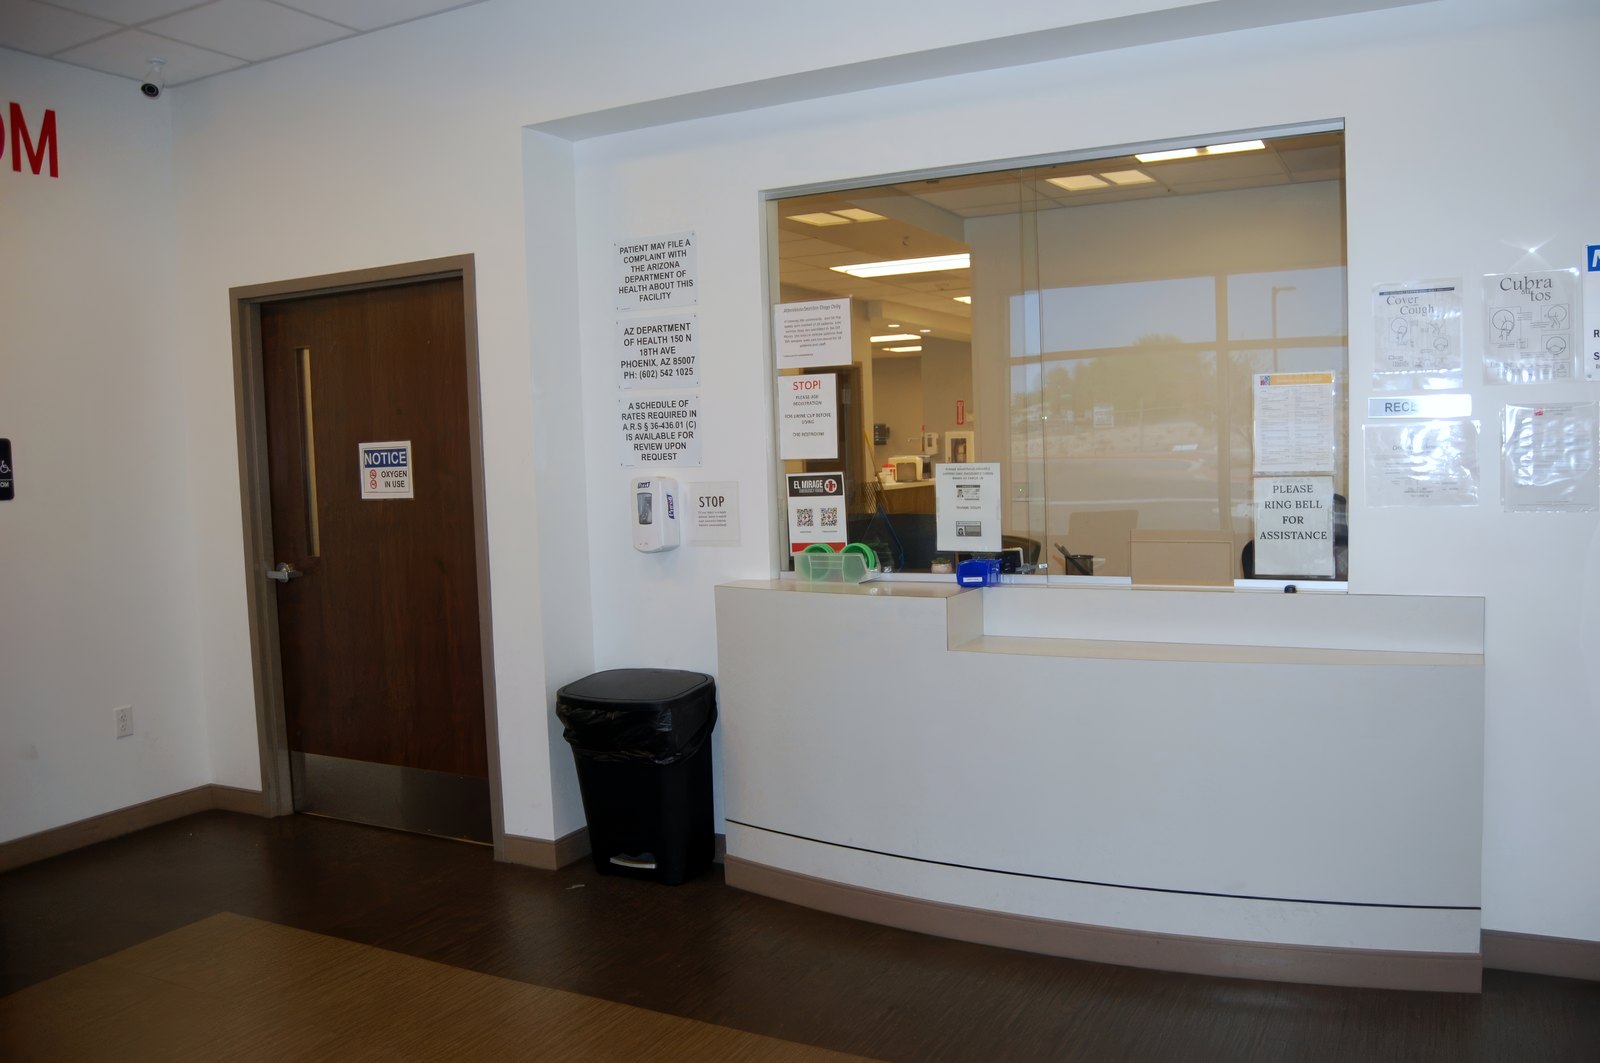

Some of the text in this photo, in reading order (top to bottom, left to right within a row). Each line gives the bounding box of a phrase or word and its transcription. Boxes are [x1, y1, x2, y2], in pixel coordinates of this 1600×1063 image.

[0, 102, 59, 178] M
[619, 244, 648, 254] PATIENT
[650, 242, 665, 251] MAY
[667, 240, 683, 248] FILE
[623, 249, 687, 264] COMPLAINT WITH
[631, 260, 680, 273] THE ARIZONA
[624, 269, 687, 284] DEPARTMENT OF
[618, 279, 694, 294] HEALTH ABOUT THIS
[1500, 276, 1553, 292] Cubra
[639, 291, 671, 302] FACILITY
[1386, 296, 1420, 305] Cover
[1399, 304, 1434, 316] Cough
[624, 322, 691, 336] AZ DEPARTMENT
[623, 333, 692, 347] OF HEALTH 150 N
[639, 346, 676, 356] 18TH AVE
[660, 357, 671, 366] AZ
[672, 356, 695, 366] 85007
[623, 367, 694, 380] PH: (602) 542 1025
[793, 380, 821, 390] STOP!
[628, 399, 689, 411] A SCHEDULE OF
[621, 409, 697, 421] RATES REQUIRED IN
[685, 420, 697, 430] (C)
[625, 430, 694, 441] IS AVAILABLE FOR
[633, 441, 687, 451] REVIEW UPON
[364, 451, 406, 465] NOTICE
[641, 452, 677, 461] REQUEST
[380, 470, 408, 478] OXYGEN
[793, 480, 823, 489] EL MIRAGE
[1272, 484, 1314, 494] PLEASE
[698, 495, 725, 508] STOP
[1264, 500, 1323, 510] RING BELL
[1282, 515, 1304, 525] FOR
[1259, 531, 1328, 541] ASSISTANCE
